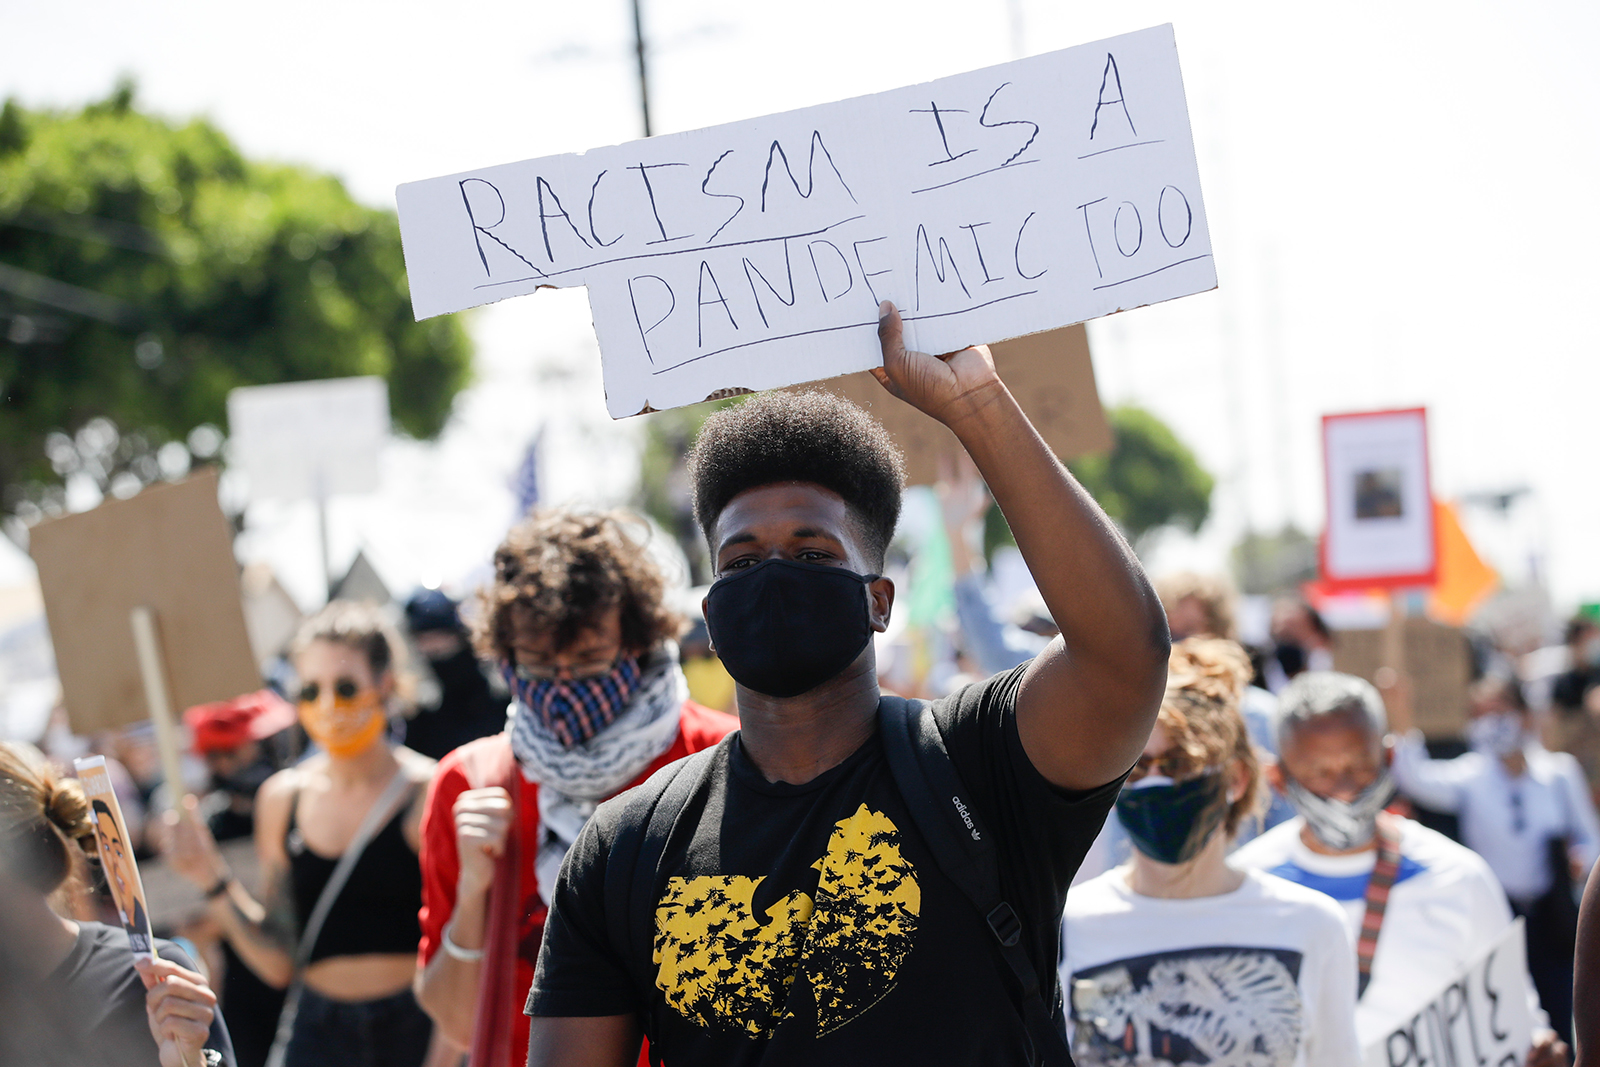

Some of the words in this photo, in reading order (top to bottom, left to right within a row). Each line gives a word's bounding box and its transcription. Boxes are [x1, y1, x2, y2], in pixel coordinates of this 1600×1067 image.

[459, 130, 859, 278] RACISM
[908, 82, 1040, 168] IS
[1090, 52, 1138, 141] A
[628, 212, 1048, 365] PANDEMIC
[1076, 185, 1192, 281] TOO
[952, 796, 975, 830] adidas
